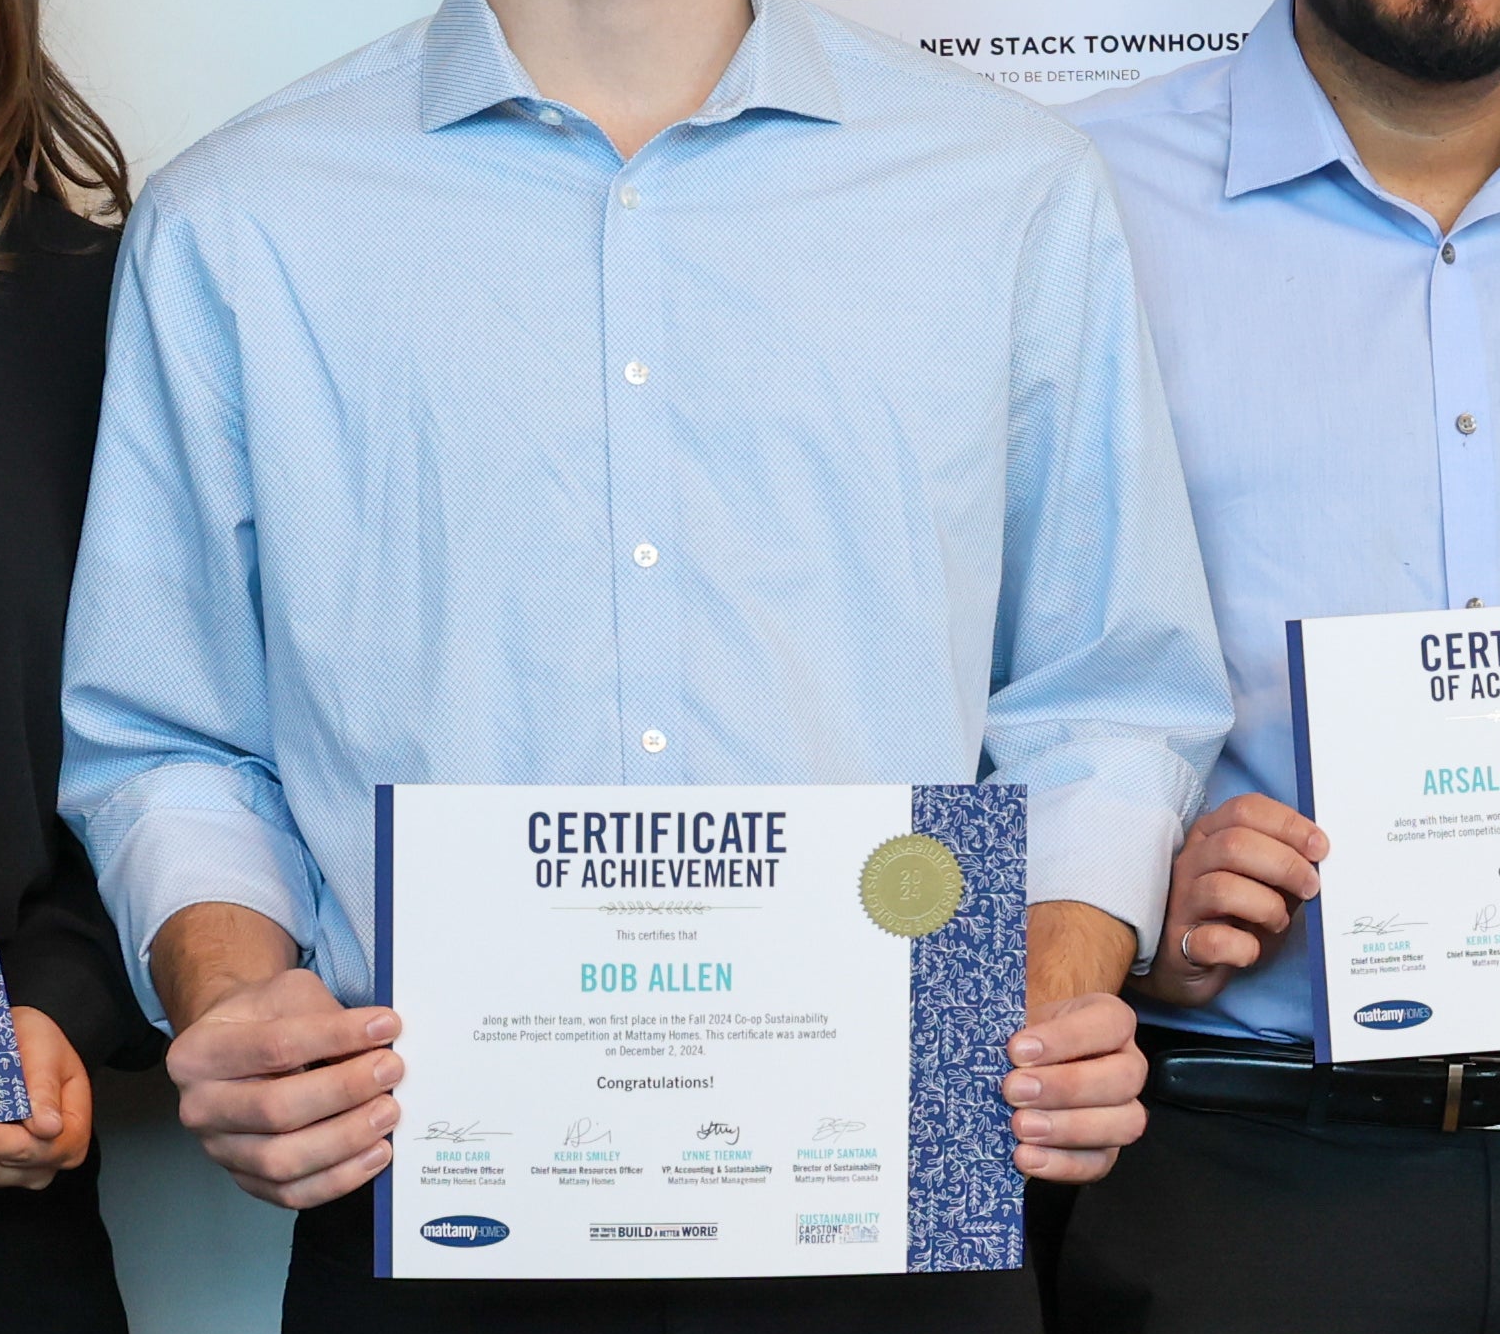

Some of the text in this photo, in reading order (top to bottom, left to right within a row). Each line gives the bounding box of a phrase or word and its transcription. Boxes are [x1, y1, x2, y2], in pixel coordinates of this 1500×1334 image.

[920, 38, 981, 57] NEW
[991, 36, 1076, 56] STACK
[1001, 69, 1140, 83] TO BE DETERMINED
[1430, 675, 1460, 702] OF
[528, 811, 787, 854] CERTIFICATE
[536, 859, 779, 888] OF ACHIEVEMENT
[616, 929, 697, 941] This certifies that
[581, 963, 733, 993] BOB ALLEN
[596, 1075, 715, 1092] Congratulations!
[436, 1151, 491, 1162] BRAD CARR
[554, 1151, 621, 1162] KERRI SMILEY
[799, 1212, 880, 1225] SUSTAINABILITY
[799, 1225, 843, 1235] CAPSTONE
[799, 1235, 836, 1245] PROJECT
